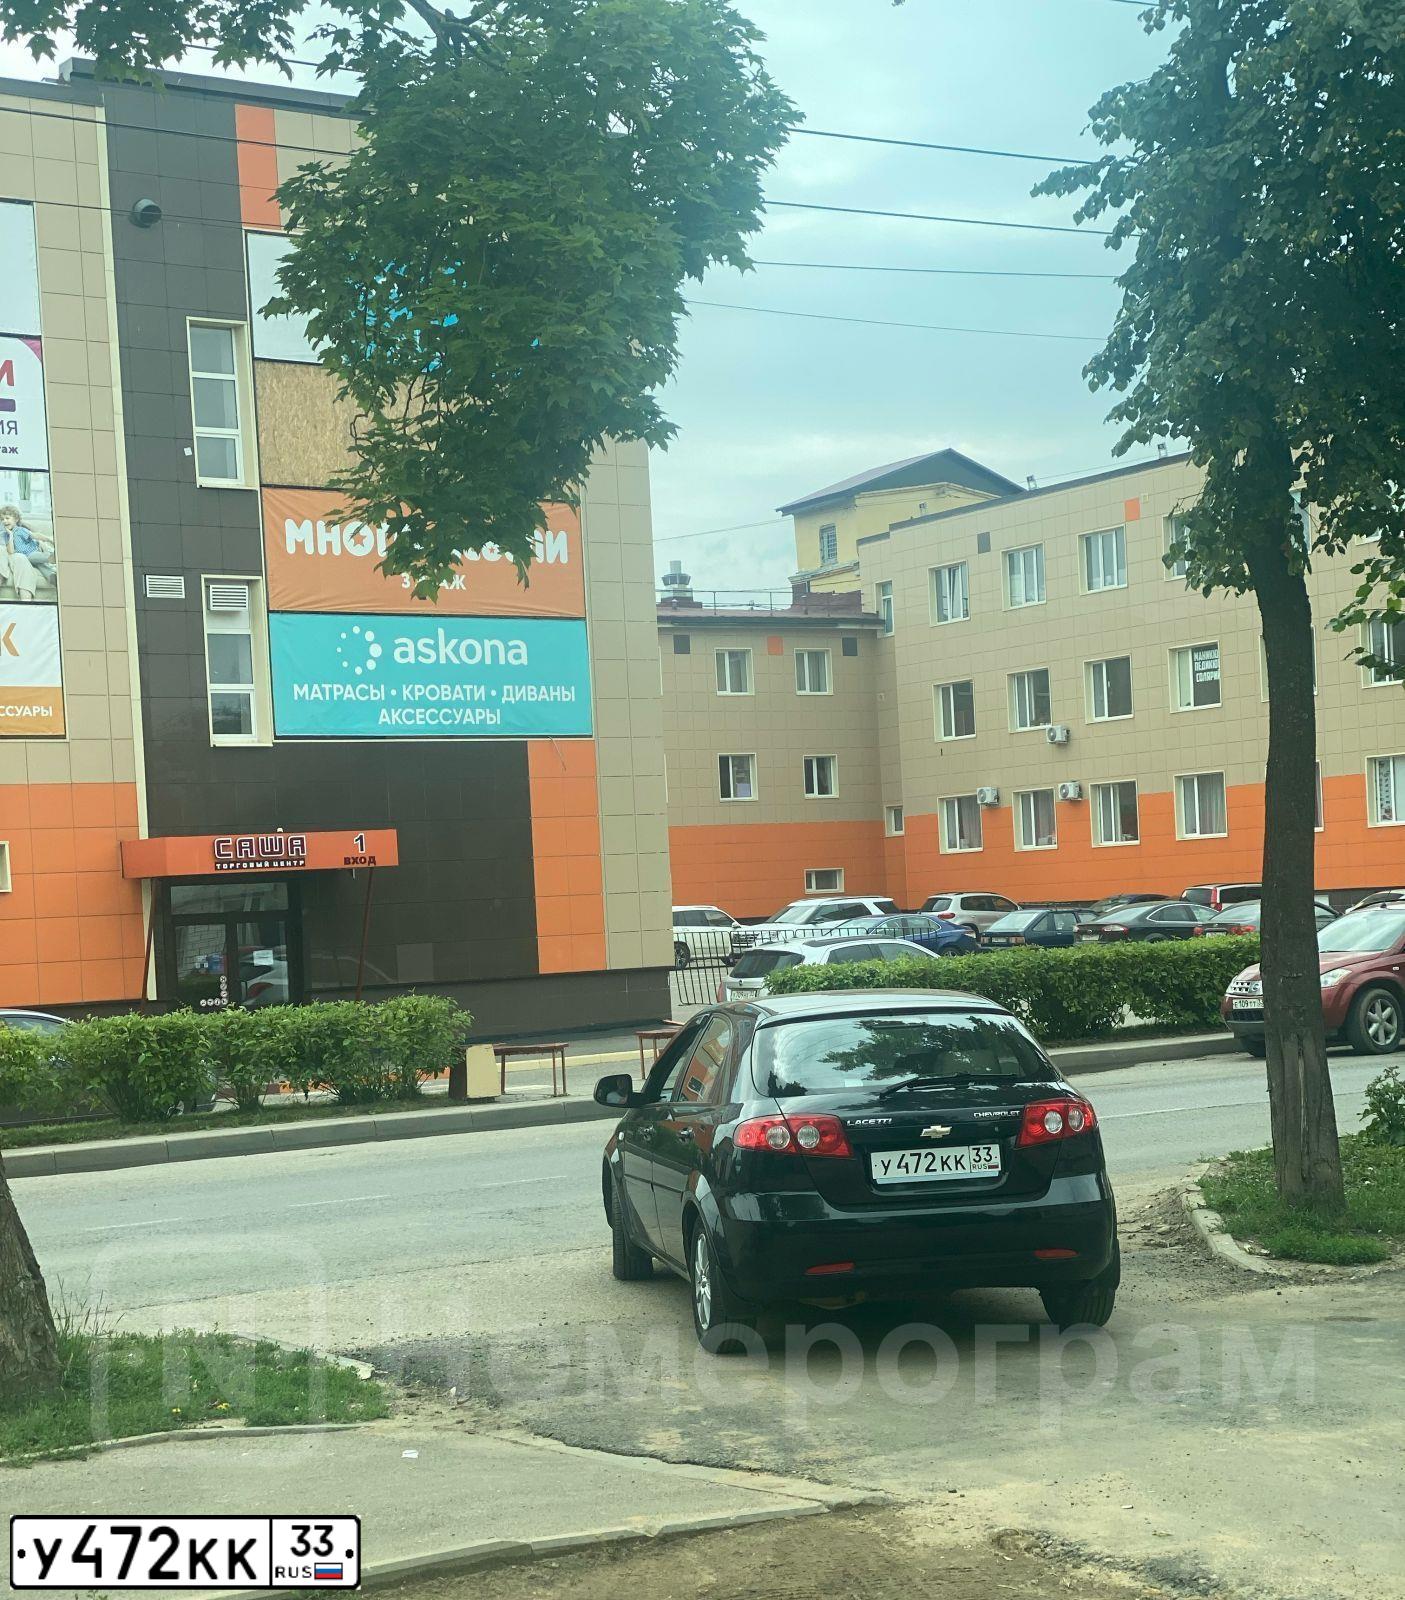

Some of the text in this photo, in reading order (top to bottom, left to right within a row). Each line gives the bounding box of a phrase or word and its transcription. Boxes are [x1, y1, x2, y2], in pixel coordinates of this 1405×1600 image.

[393, 627, 529, 666] askona
[293, 683, 576, 704] МАТРАСЫ КРОВАТИ ДИВАНЫ
[378, 707, 501, 725] АКСЕССУАРЫ
[214, 835, 307, 859] САША
[353, 832, 366, 854] 1
[215, 859, 305, 870] ТОРГОВЫЙ ЦЕНТР
[343, 855, 377, 866] ВХОД
[846, 1117, 893, 1127] LACETTI
[973, 1110, 1020, 1118] CHEVROLET
[880, 1146, 993, 1176] У472КК 33
